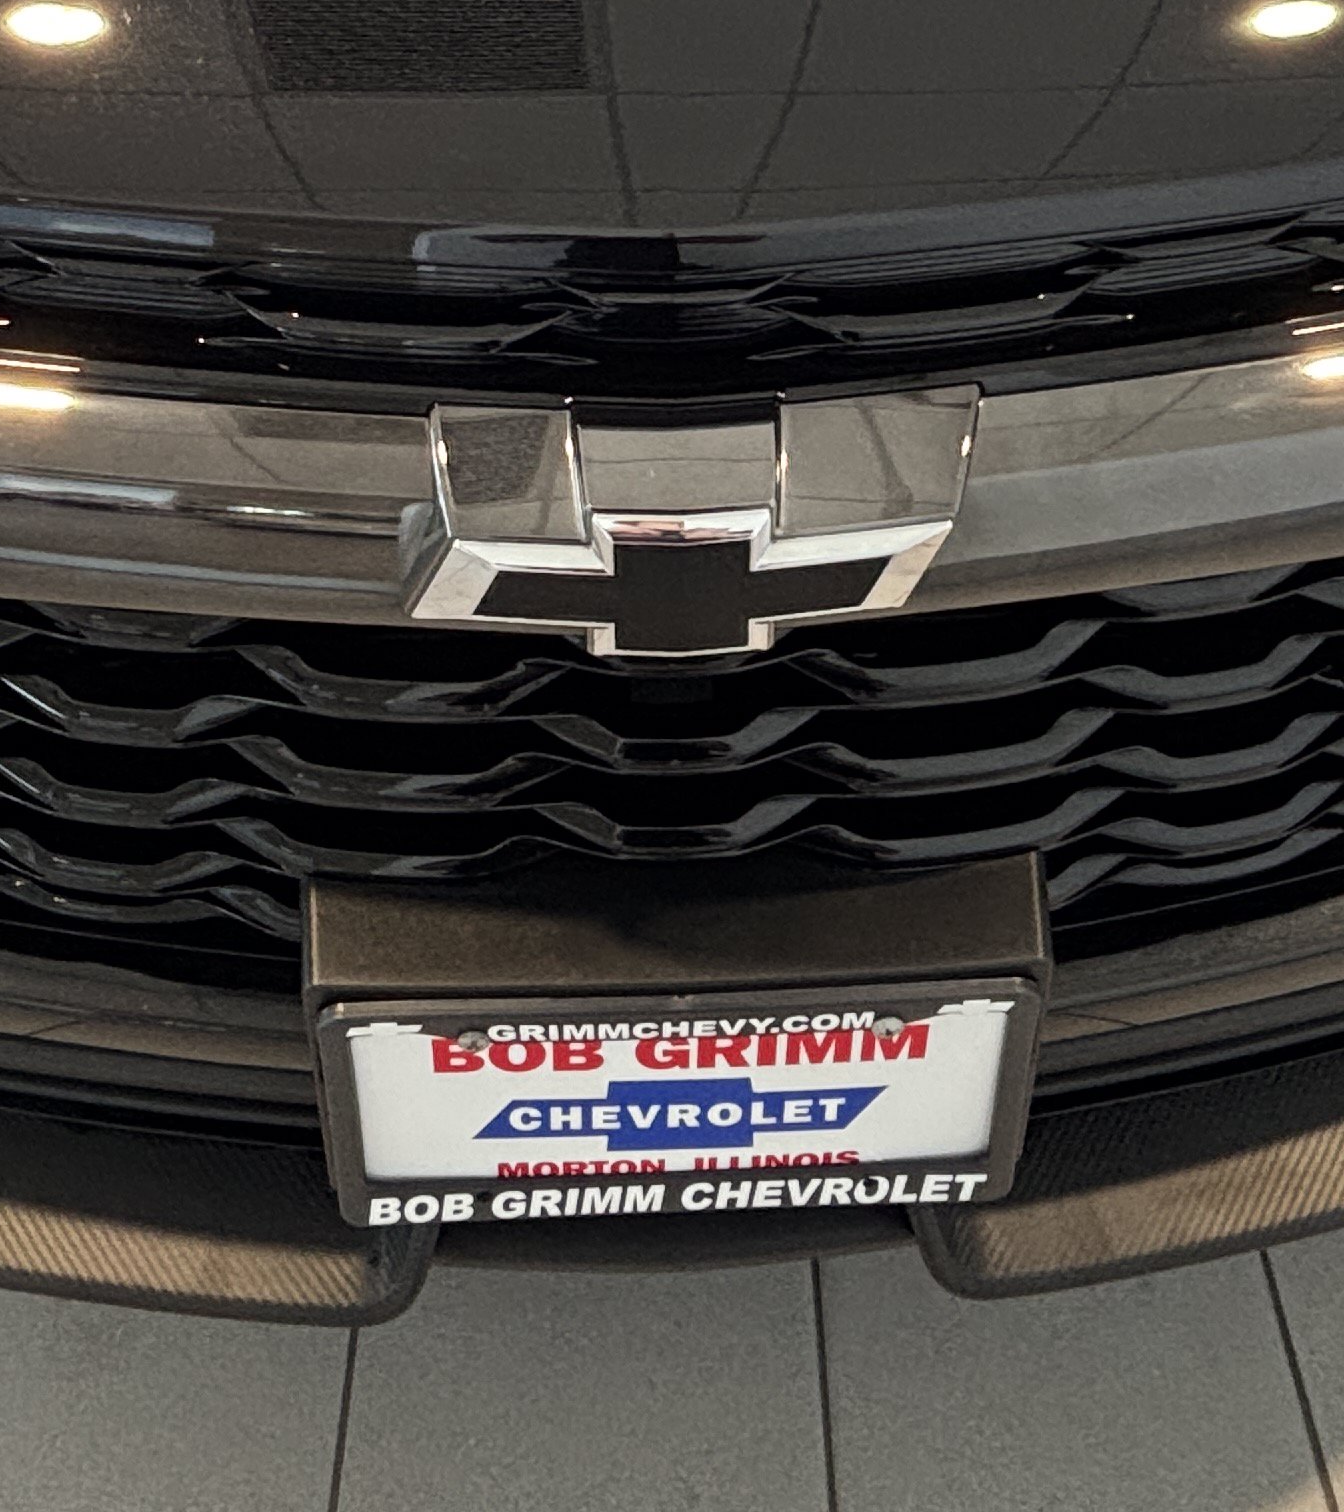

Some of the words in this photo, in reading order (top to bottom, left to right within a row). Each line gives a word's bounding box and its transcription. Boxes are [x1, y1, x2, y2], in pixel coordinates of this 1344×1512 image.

[486, 1011, 876, 1042] GRIMMCHEVY.COM
[431, 1038, 605, 1073] BOB
[634, 1023, 931, 1070] GRIMM
[508, 1096, 846, 1131] CHEVROLET
[496, 1158, 667, 1179] MORTON
[368, 1193, 476, 1226] BOB
[490, 1184, 667, 1220] GRIMM
[680, 1173, 989, 1212] CHEVROLET
